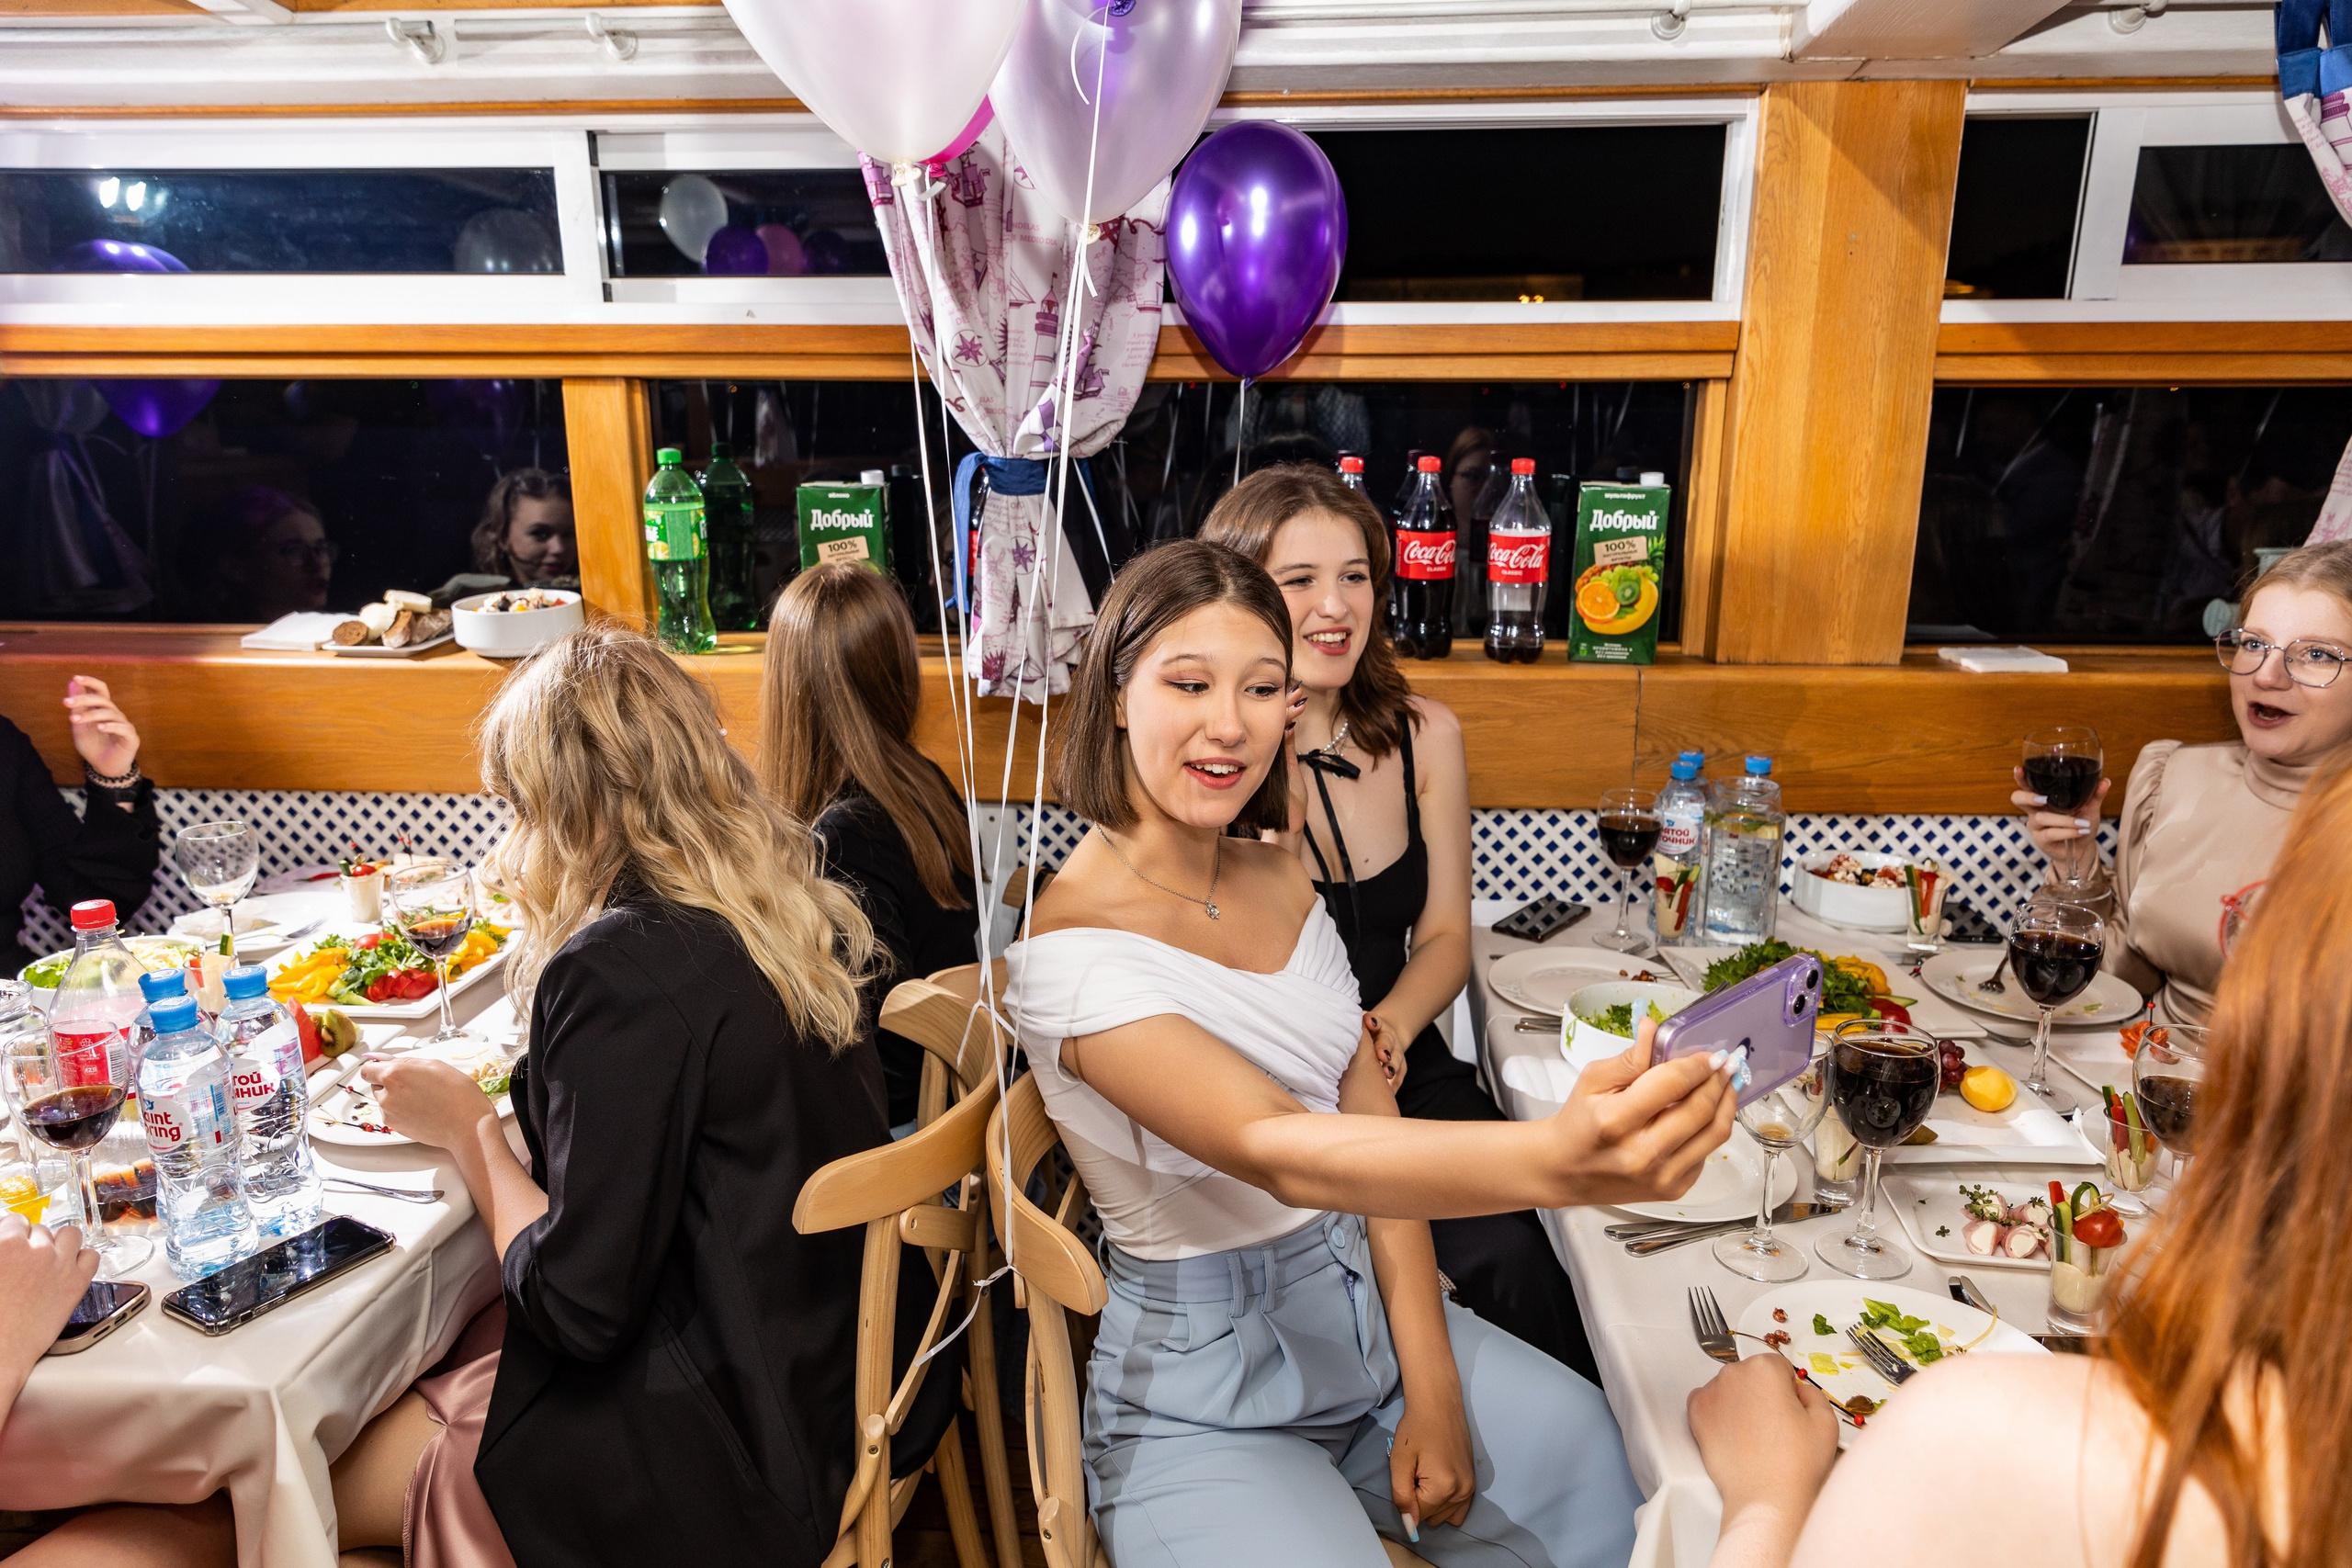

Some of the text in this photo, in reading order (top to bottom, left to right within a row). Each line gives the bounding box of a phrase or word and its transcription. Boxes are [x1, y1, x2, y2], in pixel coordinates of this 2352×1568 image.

[810, 508, 874, 531] Добрый
[1589, 509, 1657, 532] Добрый
[828, 539, 857, 553] 100%
[1404, 539, 1456, 565] Coca-Col
[1605, 540, 1636, 552] 100%
[142, 1111, 173, 1125] aint
